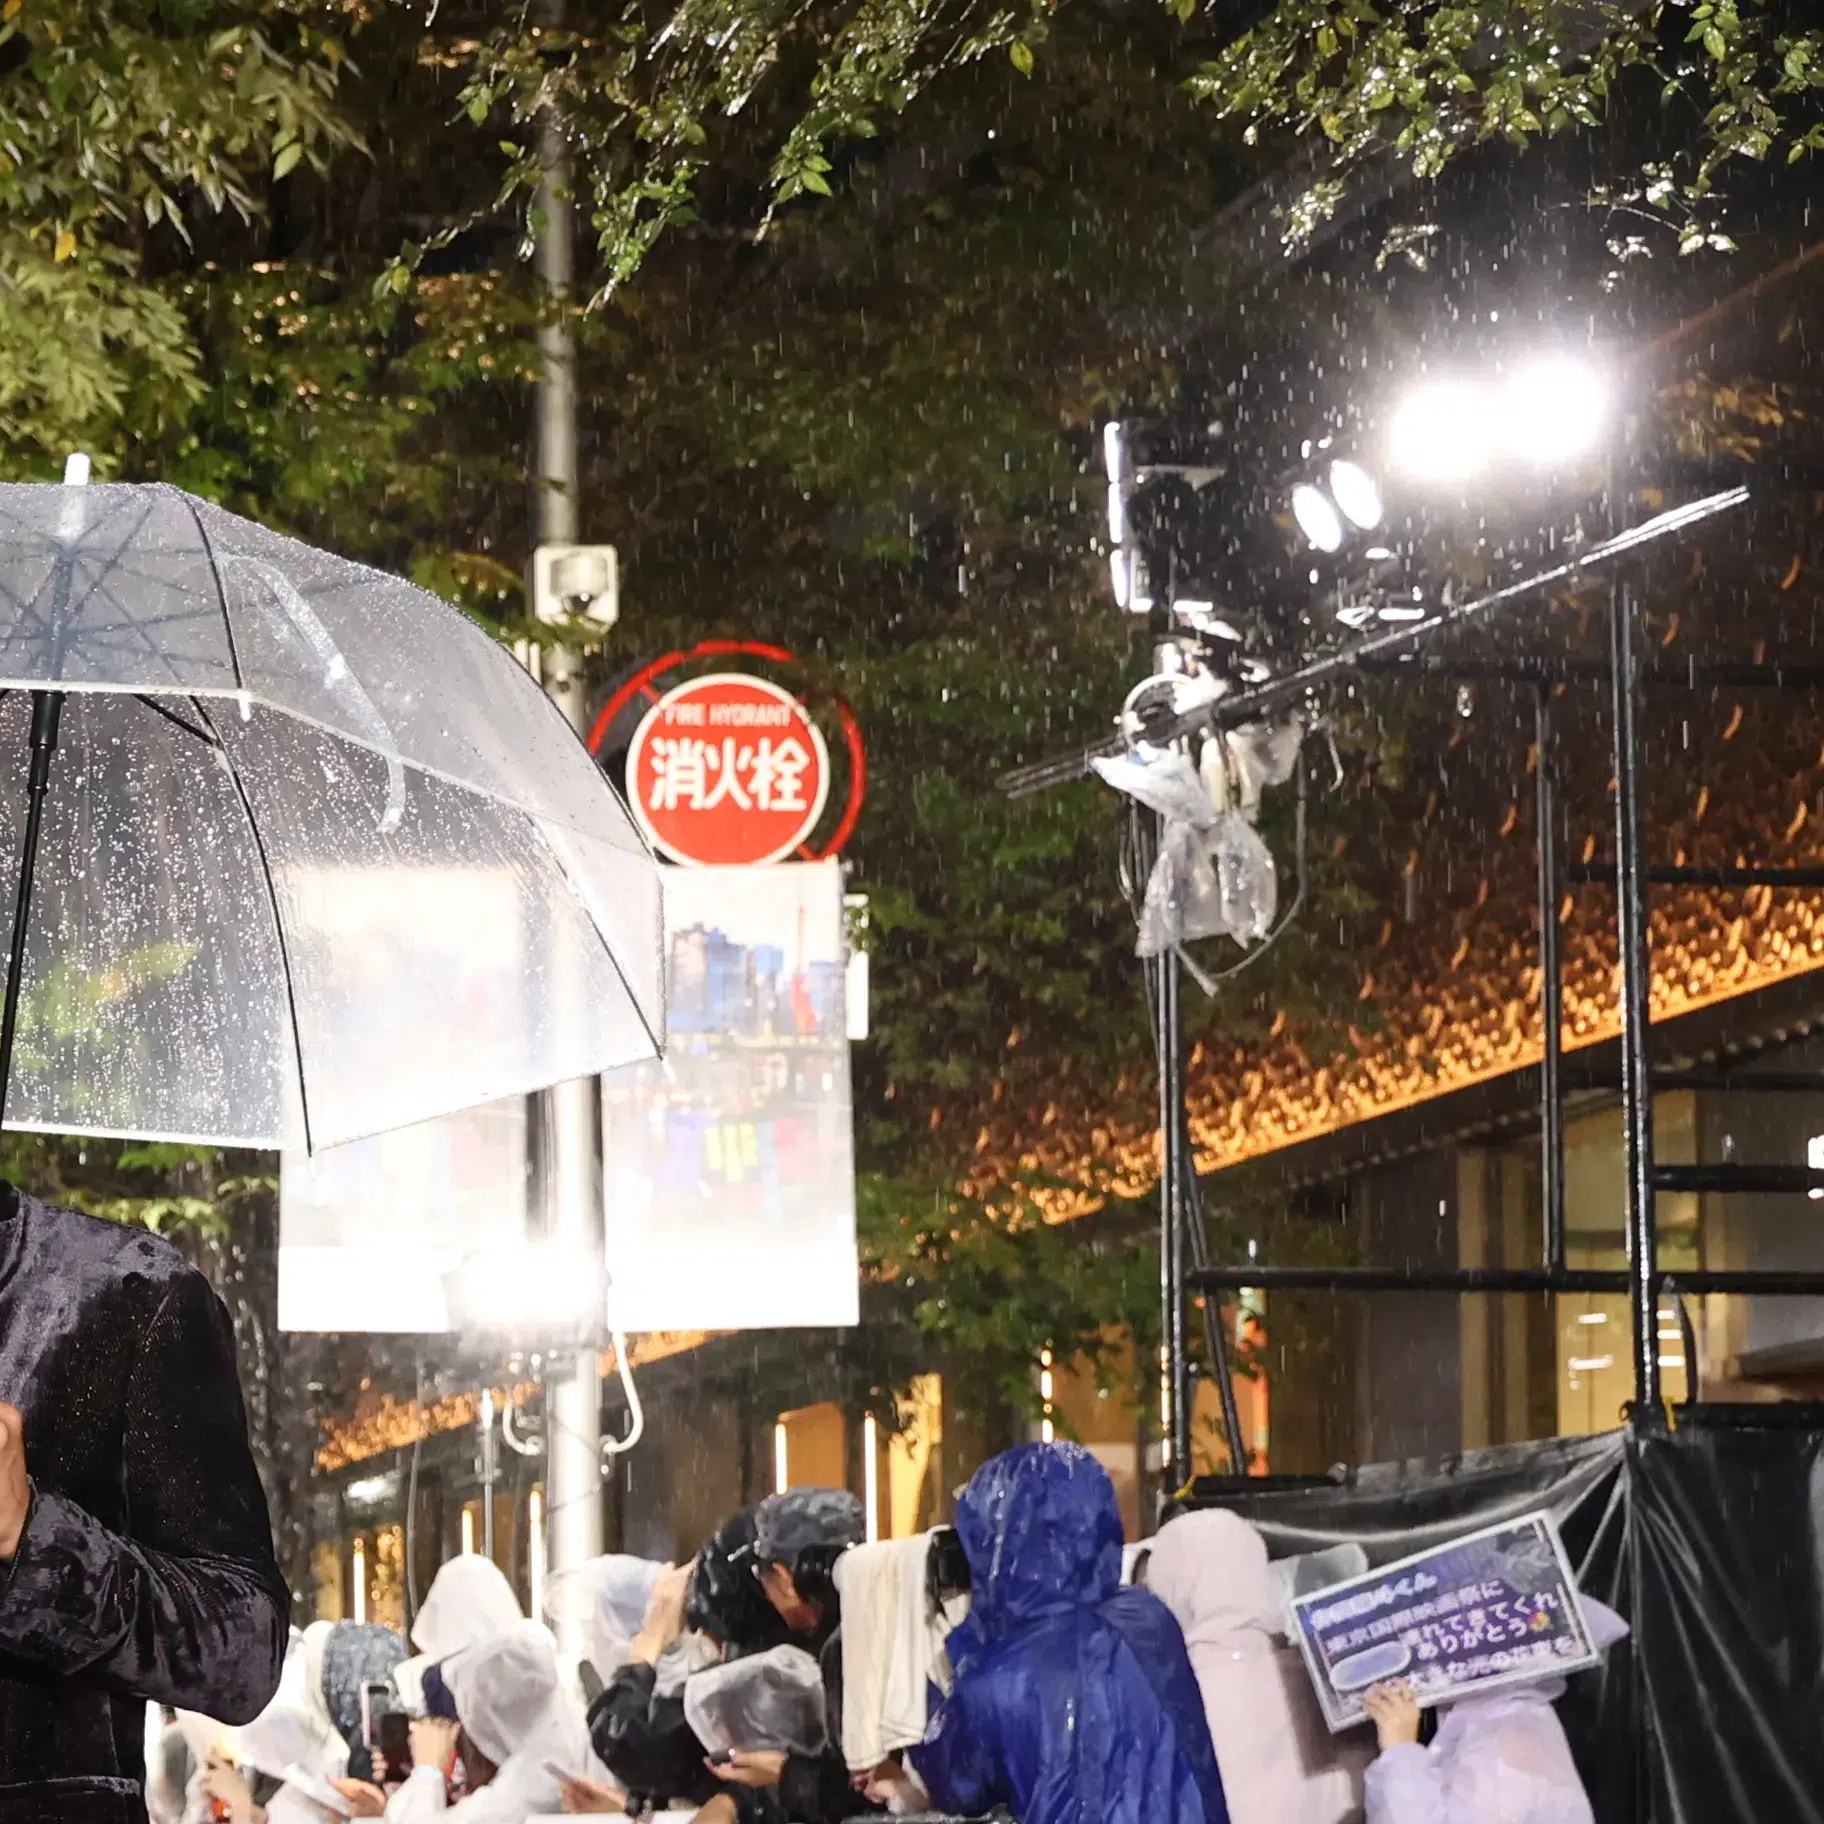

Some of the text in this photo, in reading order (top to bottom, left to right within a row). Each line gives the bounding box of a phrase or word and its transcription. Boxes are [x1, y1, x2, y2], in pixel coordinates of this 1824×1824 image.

[664, 703, 792, 728] FIRE HYDRANT
[648, 736, 811, 812] 消火栓
